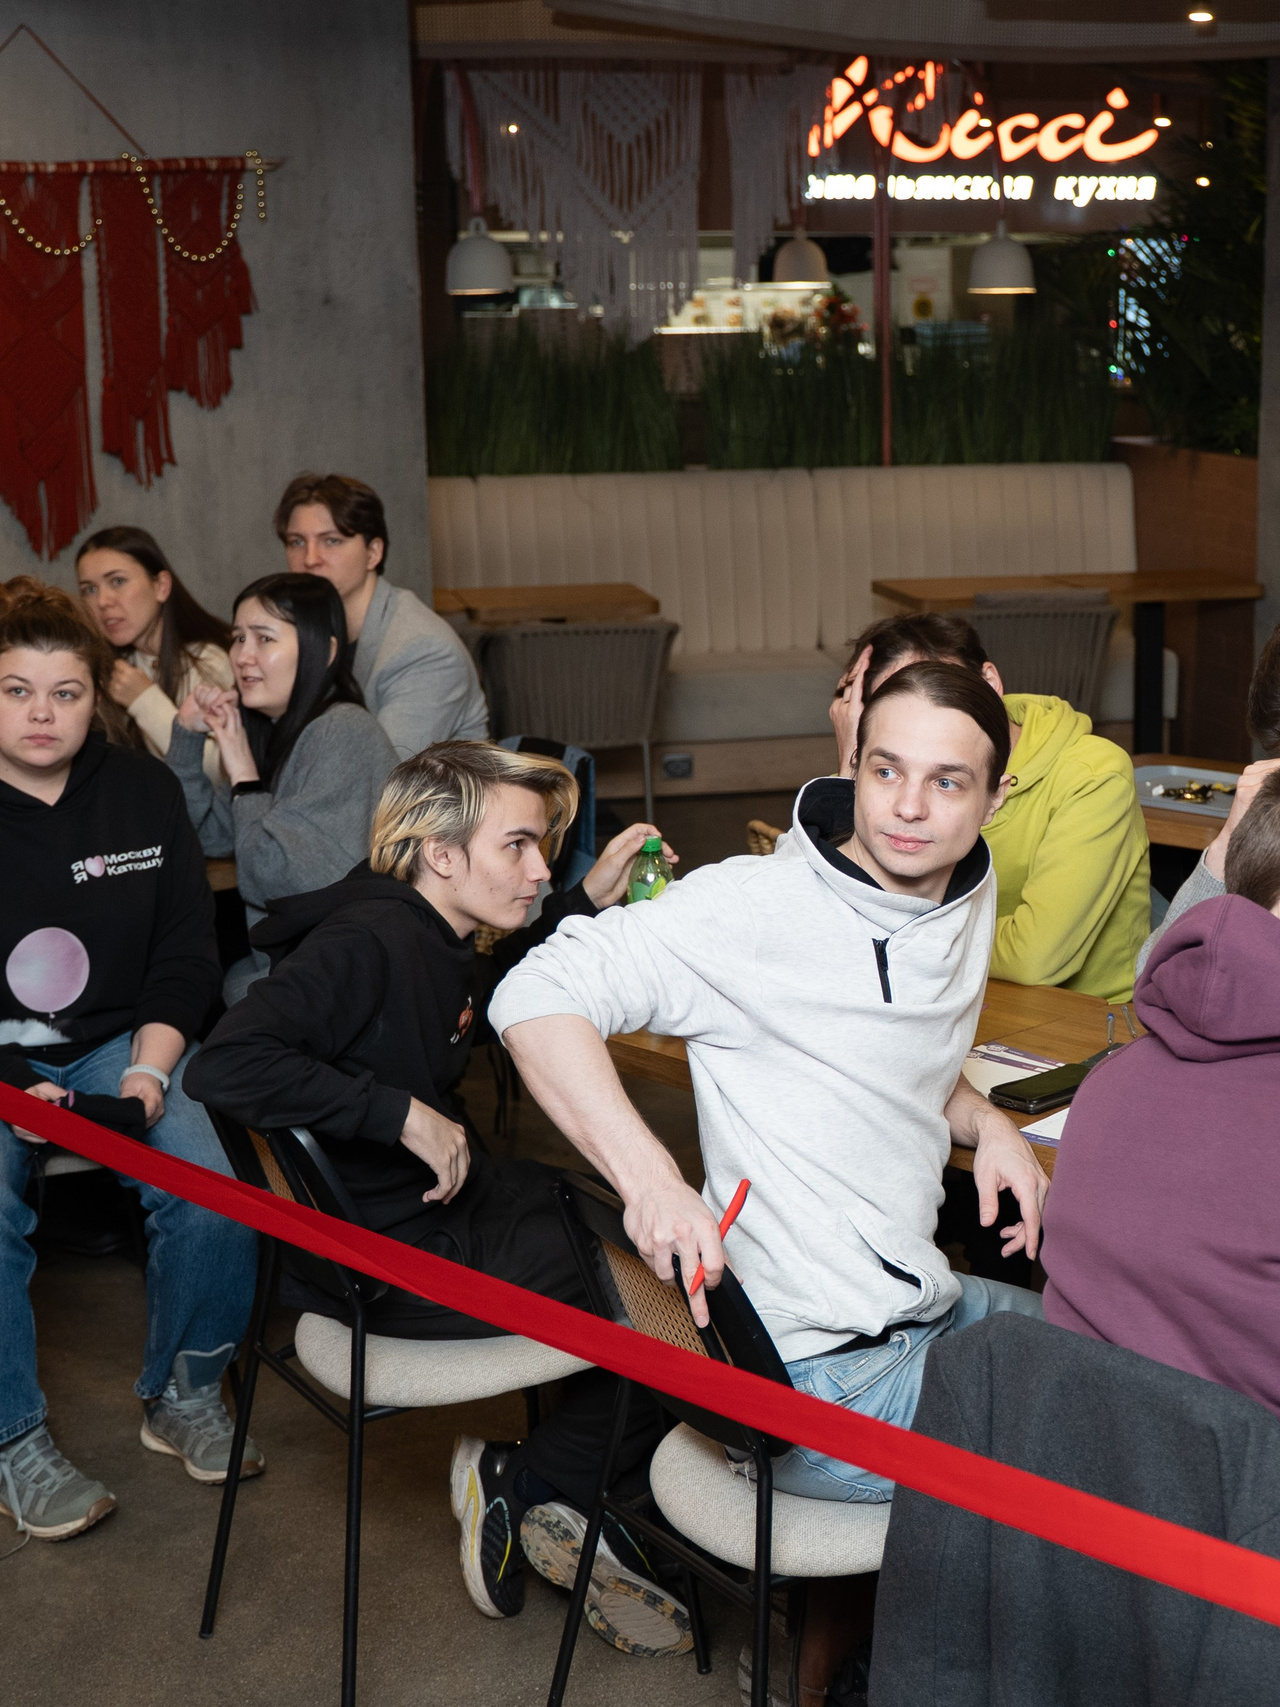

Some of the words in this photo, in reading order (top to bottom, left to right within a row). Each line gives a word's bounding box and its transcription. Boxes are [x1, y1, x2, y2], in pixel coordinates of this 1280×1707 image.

[71, 860, 85, 873] Я
[103, 845, 161, 864] Москву
[74, 871, 88, 884] Я
[106, 857, 163, 875] Катюшу
